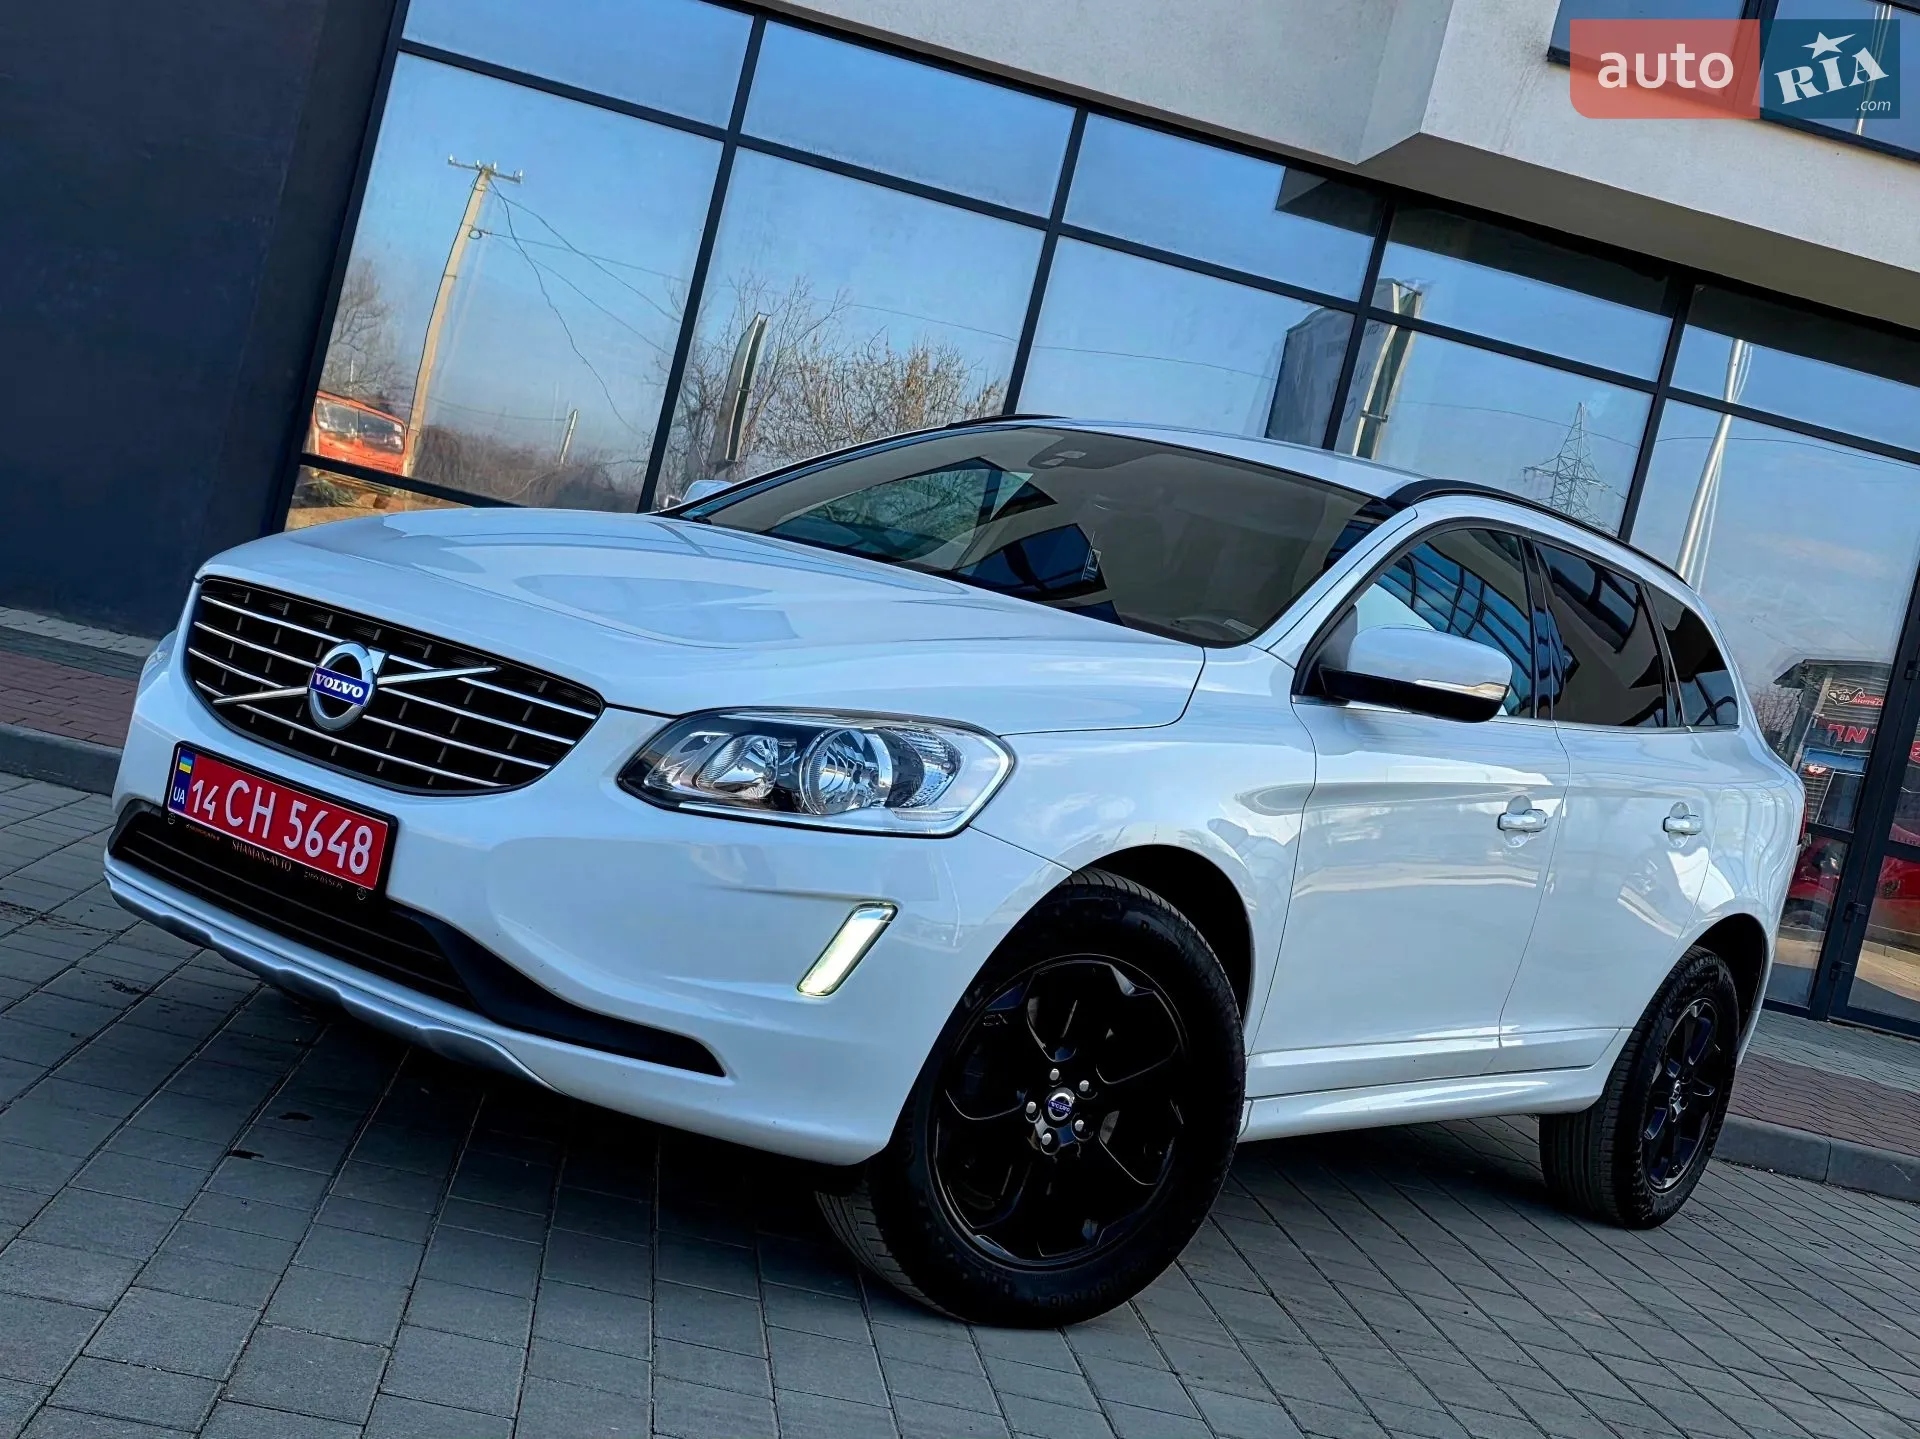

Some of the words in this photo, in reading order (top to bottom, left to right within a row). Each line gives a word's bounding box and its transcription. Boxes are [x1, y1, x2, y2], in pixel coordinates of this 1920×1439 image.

[315, 673, 364, 698] VOLVO
[173, 786, 185, 805] UA
[192, 779, 219, 821] 14
[225, 779, 277, 839] CH
[283, 799, 373, 875] 5648
